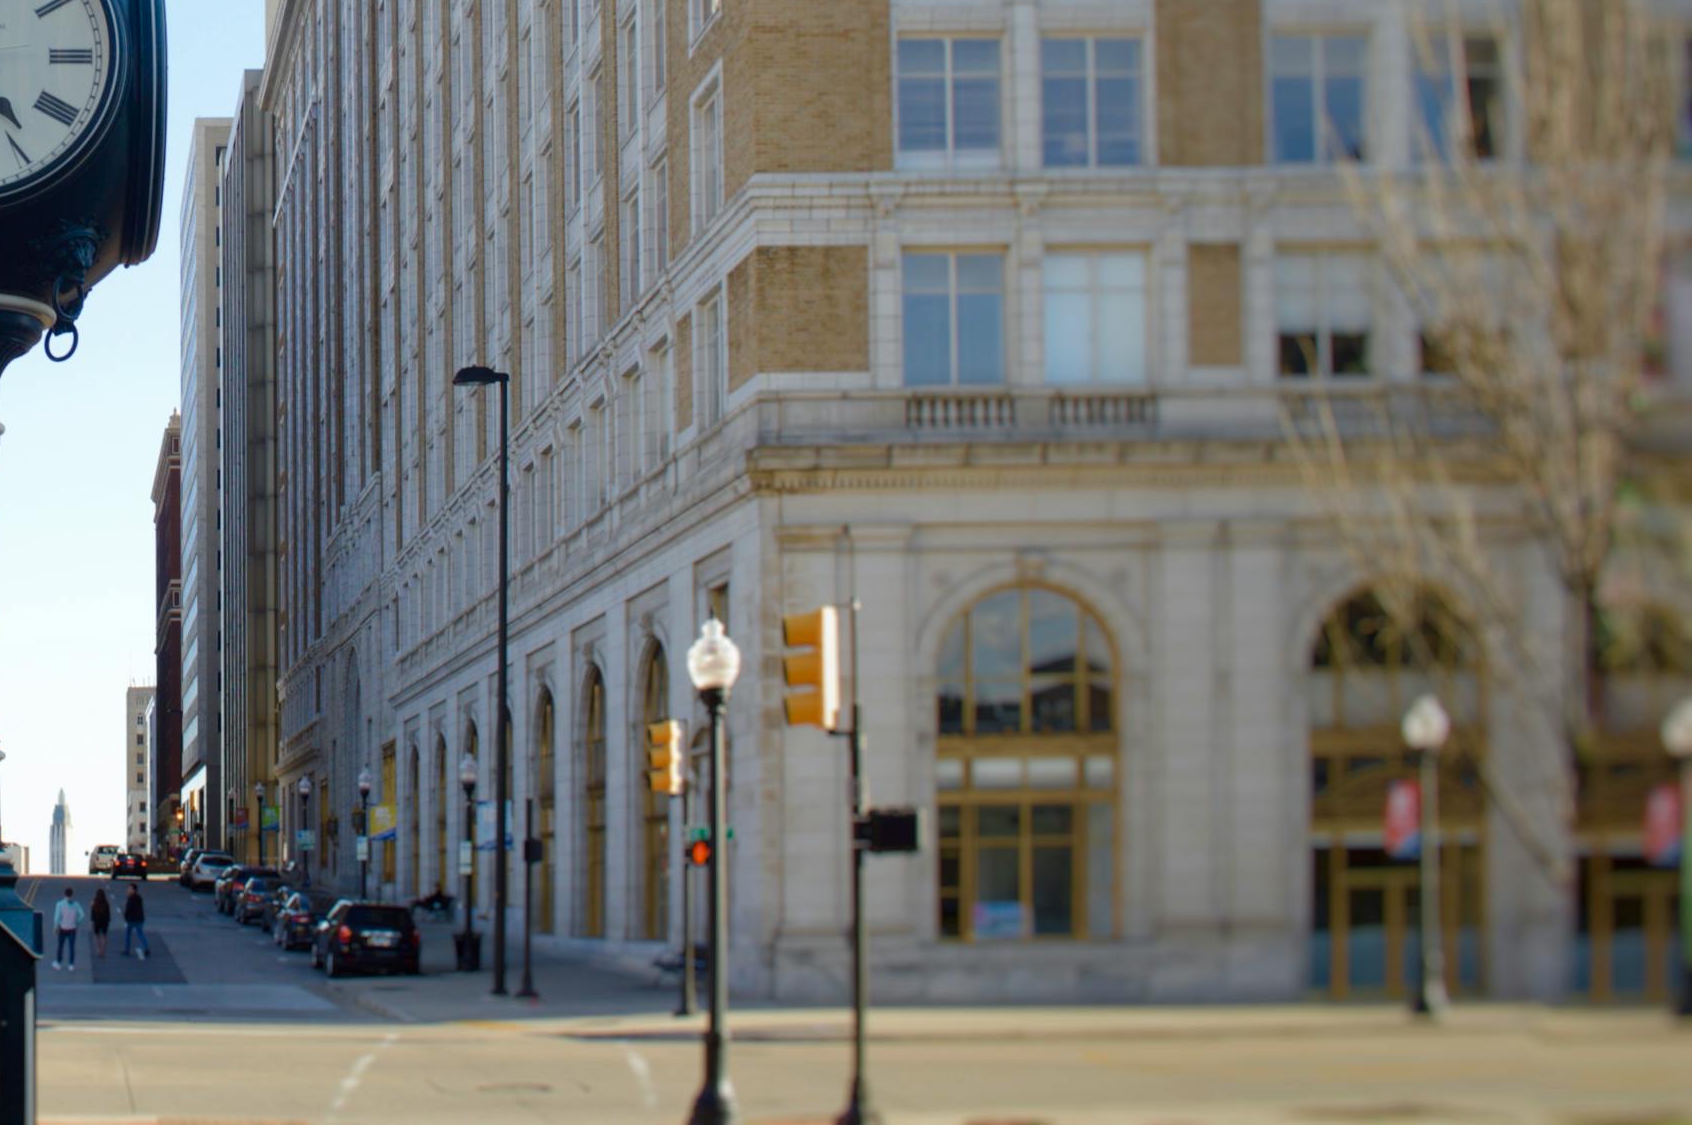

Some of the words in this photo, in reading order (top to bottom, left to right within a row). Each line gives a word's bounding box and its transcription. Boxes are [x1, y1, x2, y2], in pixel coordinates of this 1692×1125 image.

[49, 47, 93, 65] III
[32, 88, 81, 127] IIII
[5, 130, 33, 169] V
